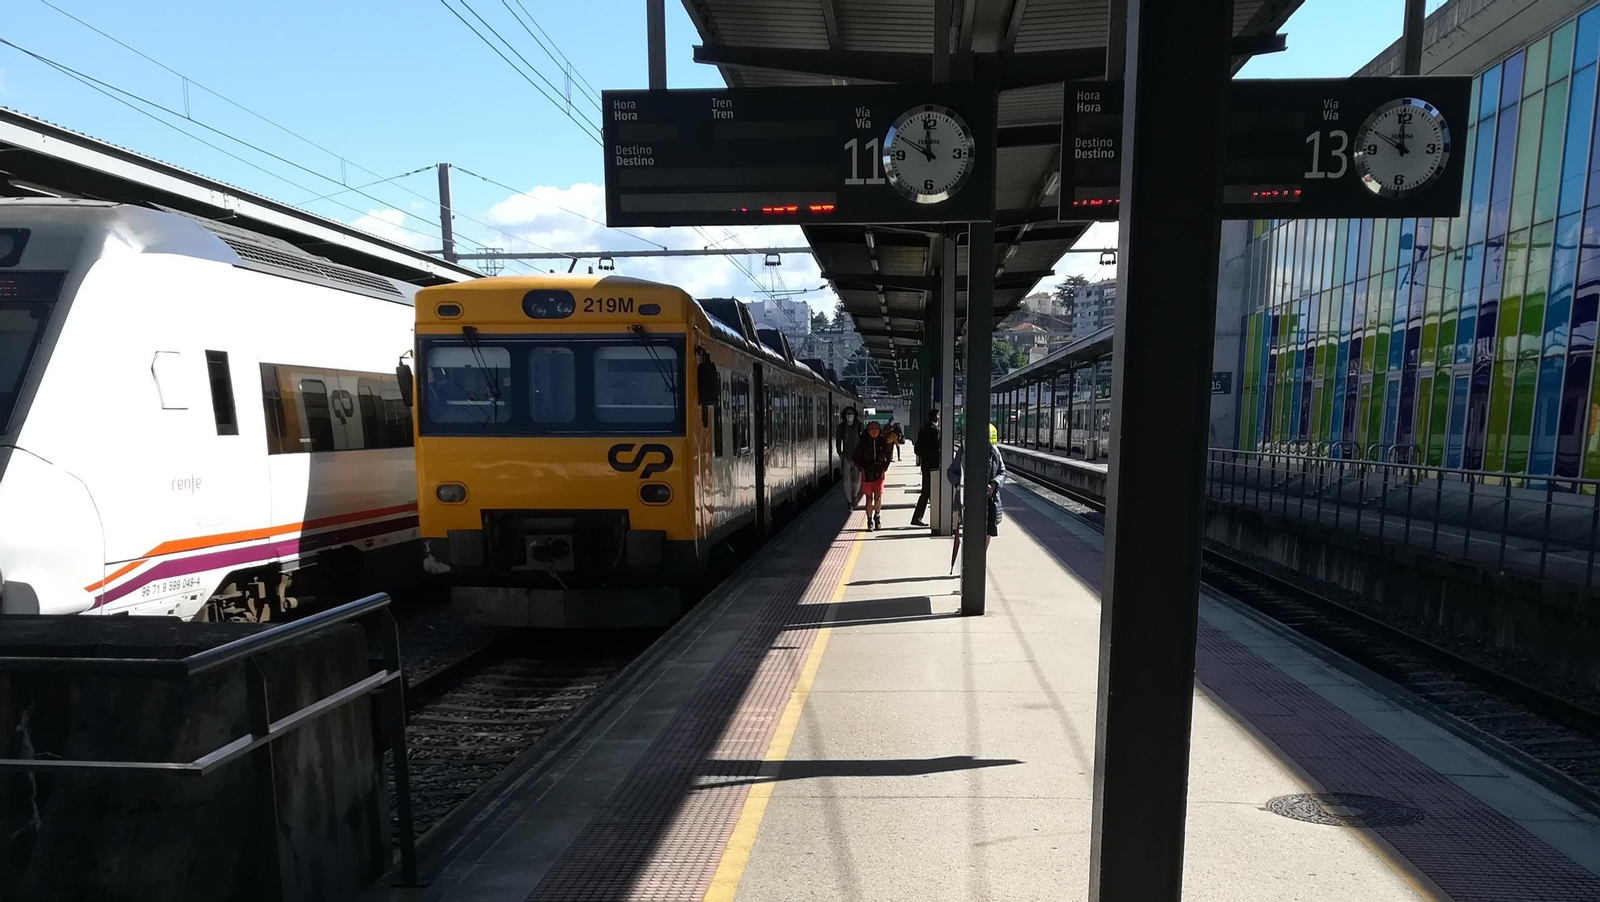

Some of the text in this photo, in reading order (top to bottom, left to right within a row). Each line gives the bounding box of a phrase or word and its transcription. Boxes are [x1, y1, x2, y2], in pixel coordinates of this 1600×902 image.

[1076, 91, 1100, 101] Hora
[613, 100, 637, 110] Hora
[711, 98, 733, 108] Tren
[1076, 102, 1101, 112] Hora
[1323, 98, 1339, 109] Vía
[614, 111, 638, 121] Hora
[711, 109, 734, 119] Tren
[855, 106, 871, 118] Vía
[1322, 109, 1339, 121] Vía
[855, 118, 872, 129] Vía
[922, 119, 938, 130] 12
[1397, 114, 1413, 124] 12
[1075, 137, 1113, 148] Destino
[615, 145, 653, 155] Destino
[952, 148, 963, 160] 3
[1075, 148, 1115, 159] Destino
[1304, 129, 1349, 179] 13
[1367, 144, 1378, 155] 9
[1426, 143, 1436, 154] 3
[616, 155, 655, 166] Destino
[895, 150, 906, 161] 9
[844, 138, 886, 185] 11
[923, 179, 934, 190] 6
[1393, 174, 1404, 185] 6
[583, 297, 634, 313] 219M
[142, 585, 151, 597] 96
[152, 584, 160, 595] 71
[162, 582, 167, 593] 9
[168, 579, 181, 591] 599
